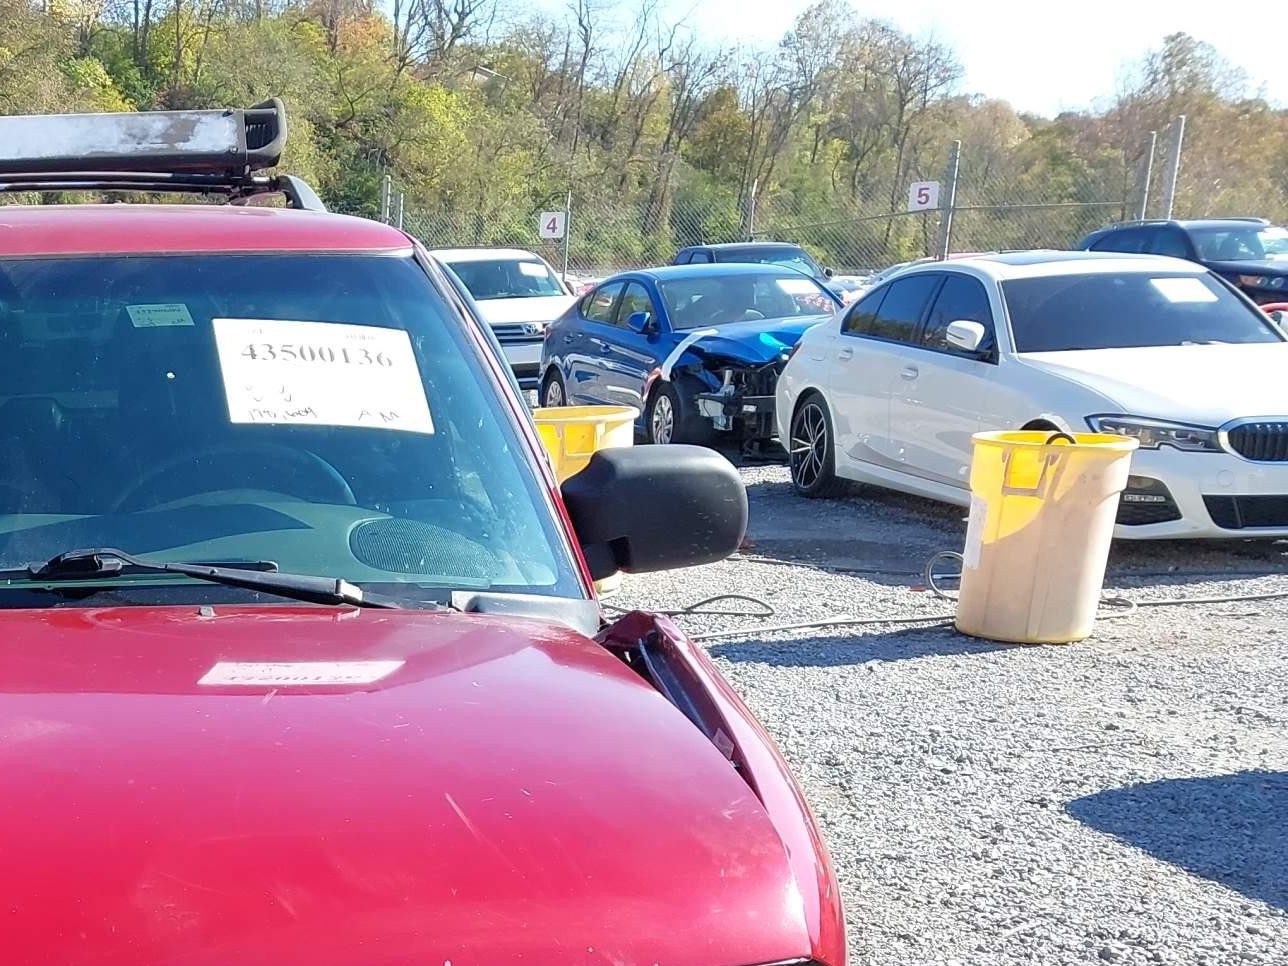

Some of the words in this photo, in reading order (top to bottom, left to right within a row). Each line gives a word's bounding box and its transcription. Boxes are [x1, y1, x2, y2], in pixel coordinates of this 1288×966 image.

[917, 187, 930, 205] 5
[546, 216, 558, 234] 4
[241, 343, 394, 367] 43500136
